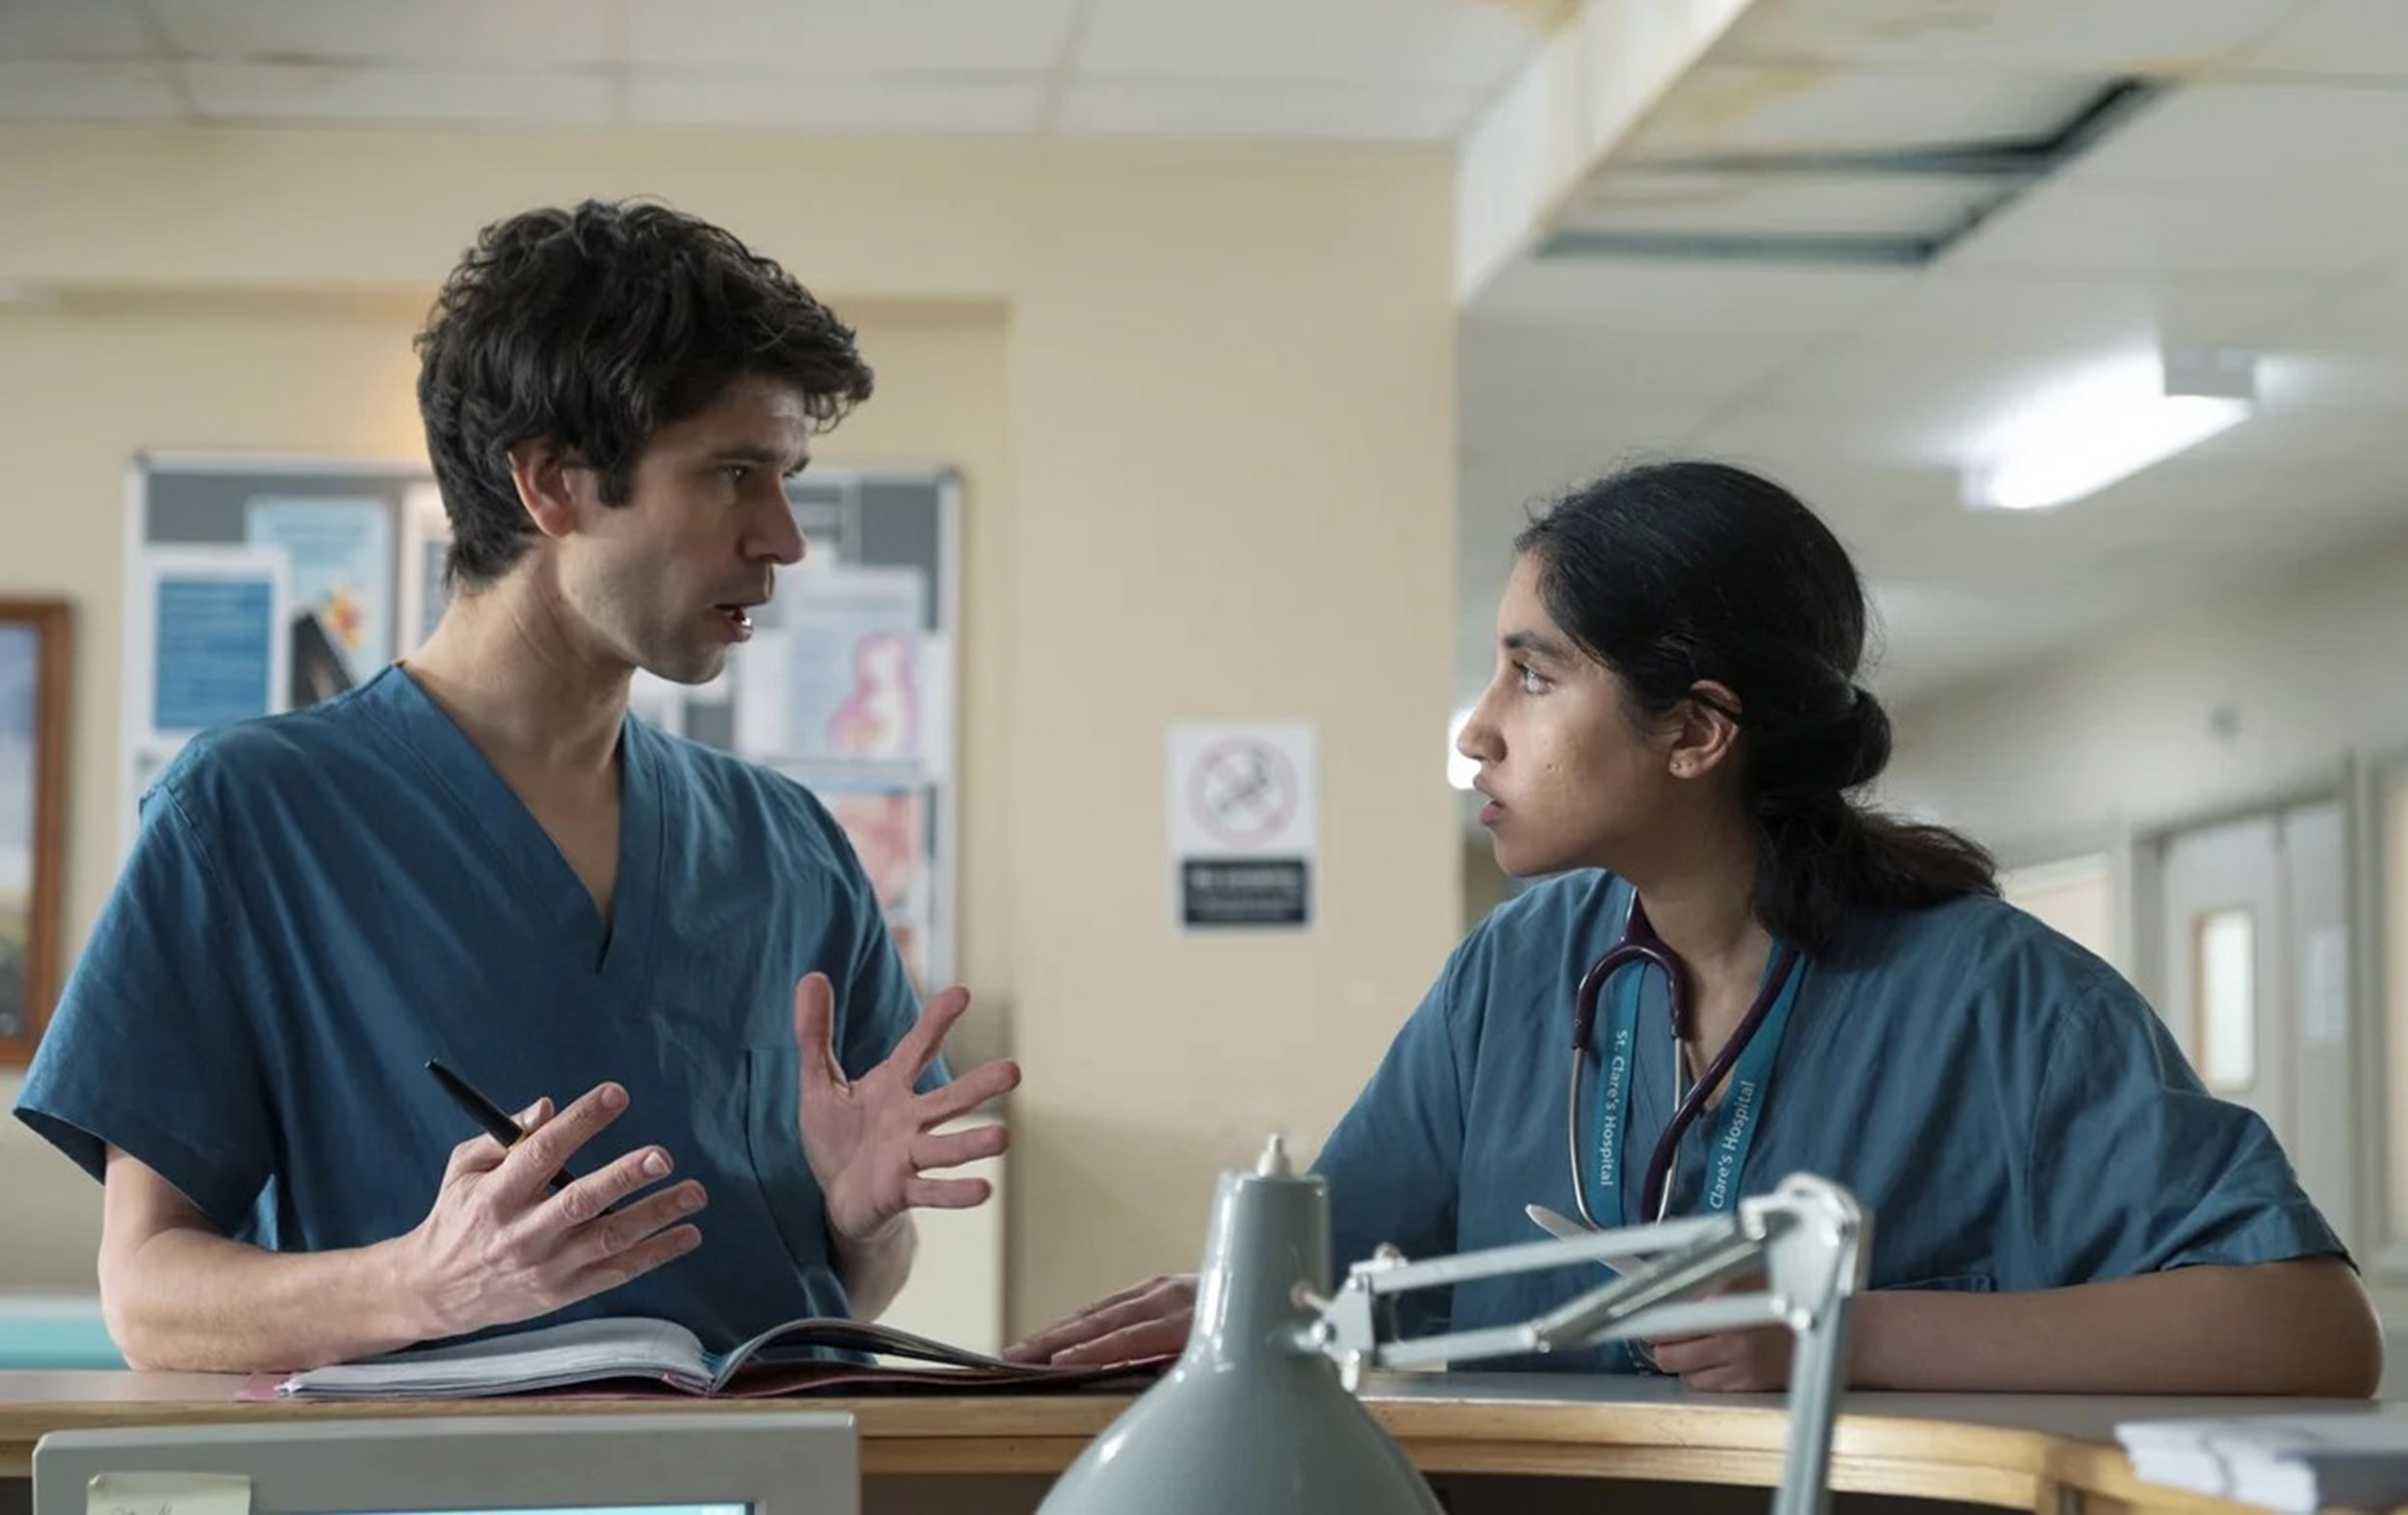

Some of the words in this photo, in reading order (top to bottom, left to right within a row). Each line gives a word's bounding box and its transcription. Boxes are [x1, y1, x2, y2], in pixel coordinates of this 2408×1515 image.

[1615, 1030, 1629, 1052] St.
[1605, 1056, 1626, 1110] Clare's
[1599, 1114, 1617, 1187] Hospital
[1709, 1154, 1734, 1210] Clare's
[1722, 1080, 1756, 1152] Hospital
